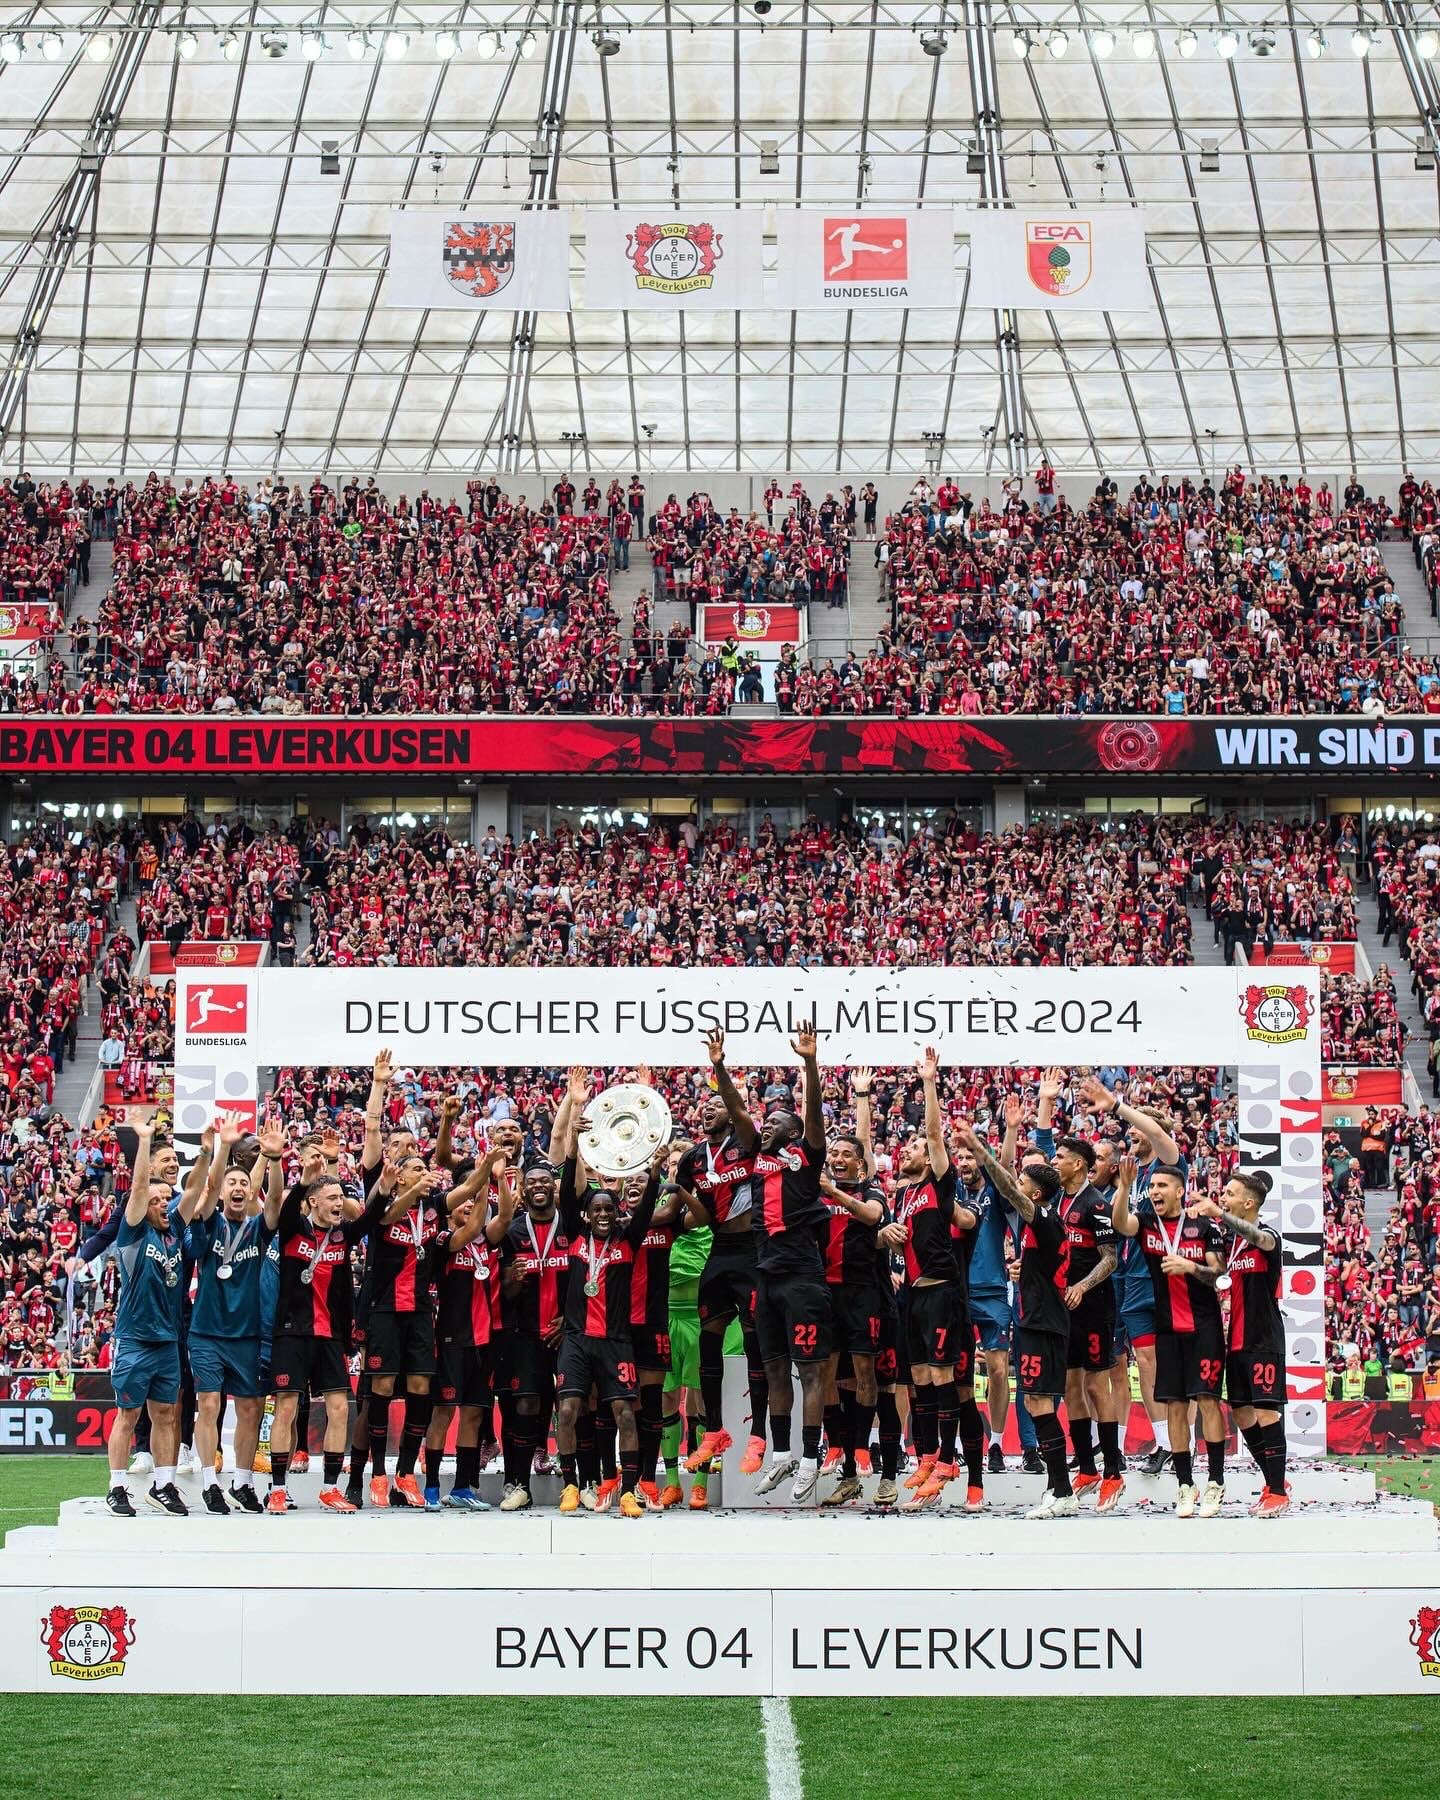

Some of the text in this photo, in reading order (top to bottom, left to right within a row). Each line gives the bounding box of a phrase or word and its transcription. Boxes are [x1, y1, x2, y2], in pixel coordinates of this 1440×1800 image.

[663, 226, 685, 237] 1904
[1034, 225, 1084, 241] FCA
[655, 253, 694, 262] BAYER
[642, 277, 707, 292] Leverkusen
[824, 286, 908, 298] BUNDESLIGA
[0, 729, 470, 763] BAYER 04 LEVERKUSEN
[1215, 728, 1310, 764] WIR.
[1319, 728, 1414, 764] SIND
[1267, 988, 1285, 996] 1904
[345, 1000, 1142, 1034] DEUTSCHER FUSSBALLMEISTER 2024
[185, 1038, 247, 1046] BUNDESLIGA
[1251, 1029, 1303, 1042] Leverkusen
[794, 1324, 817, 1345] 22
[936, 1328, 947, 1349] 7
[1088, 1333, 1100, 1355] 3
[617, 1361, 637, 1383] 30
[1020, 1354, 1042, 1377] 25
[1200, 1359, 1222, 1381] 32
[1253, 1363, 1276, 1385] 20
[77, 1609, 99, 1620] 1904
[69, 1639, 108, 1648] BAYER
[84, 1623, 92, 1664] BAYER
[496, 1627, 1143, 1670] BAYER 04 LEVERKUSEN
[56, 1663, 119, 1676] Leverkusen
